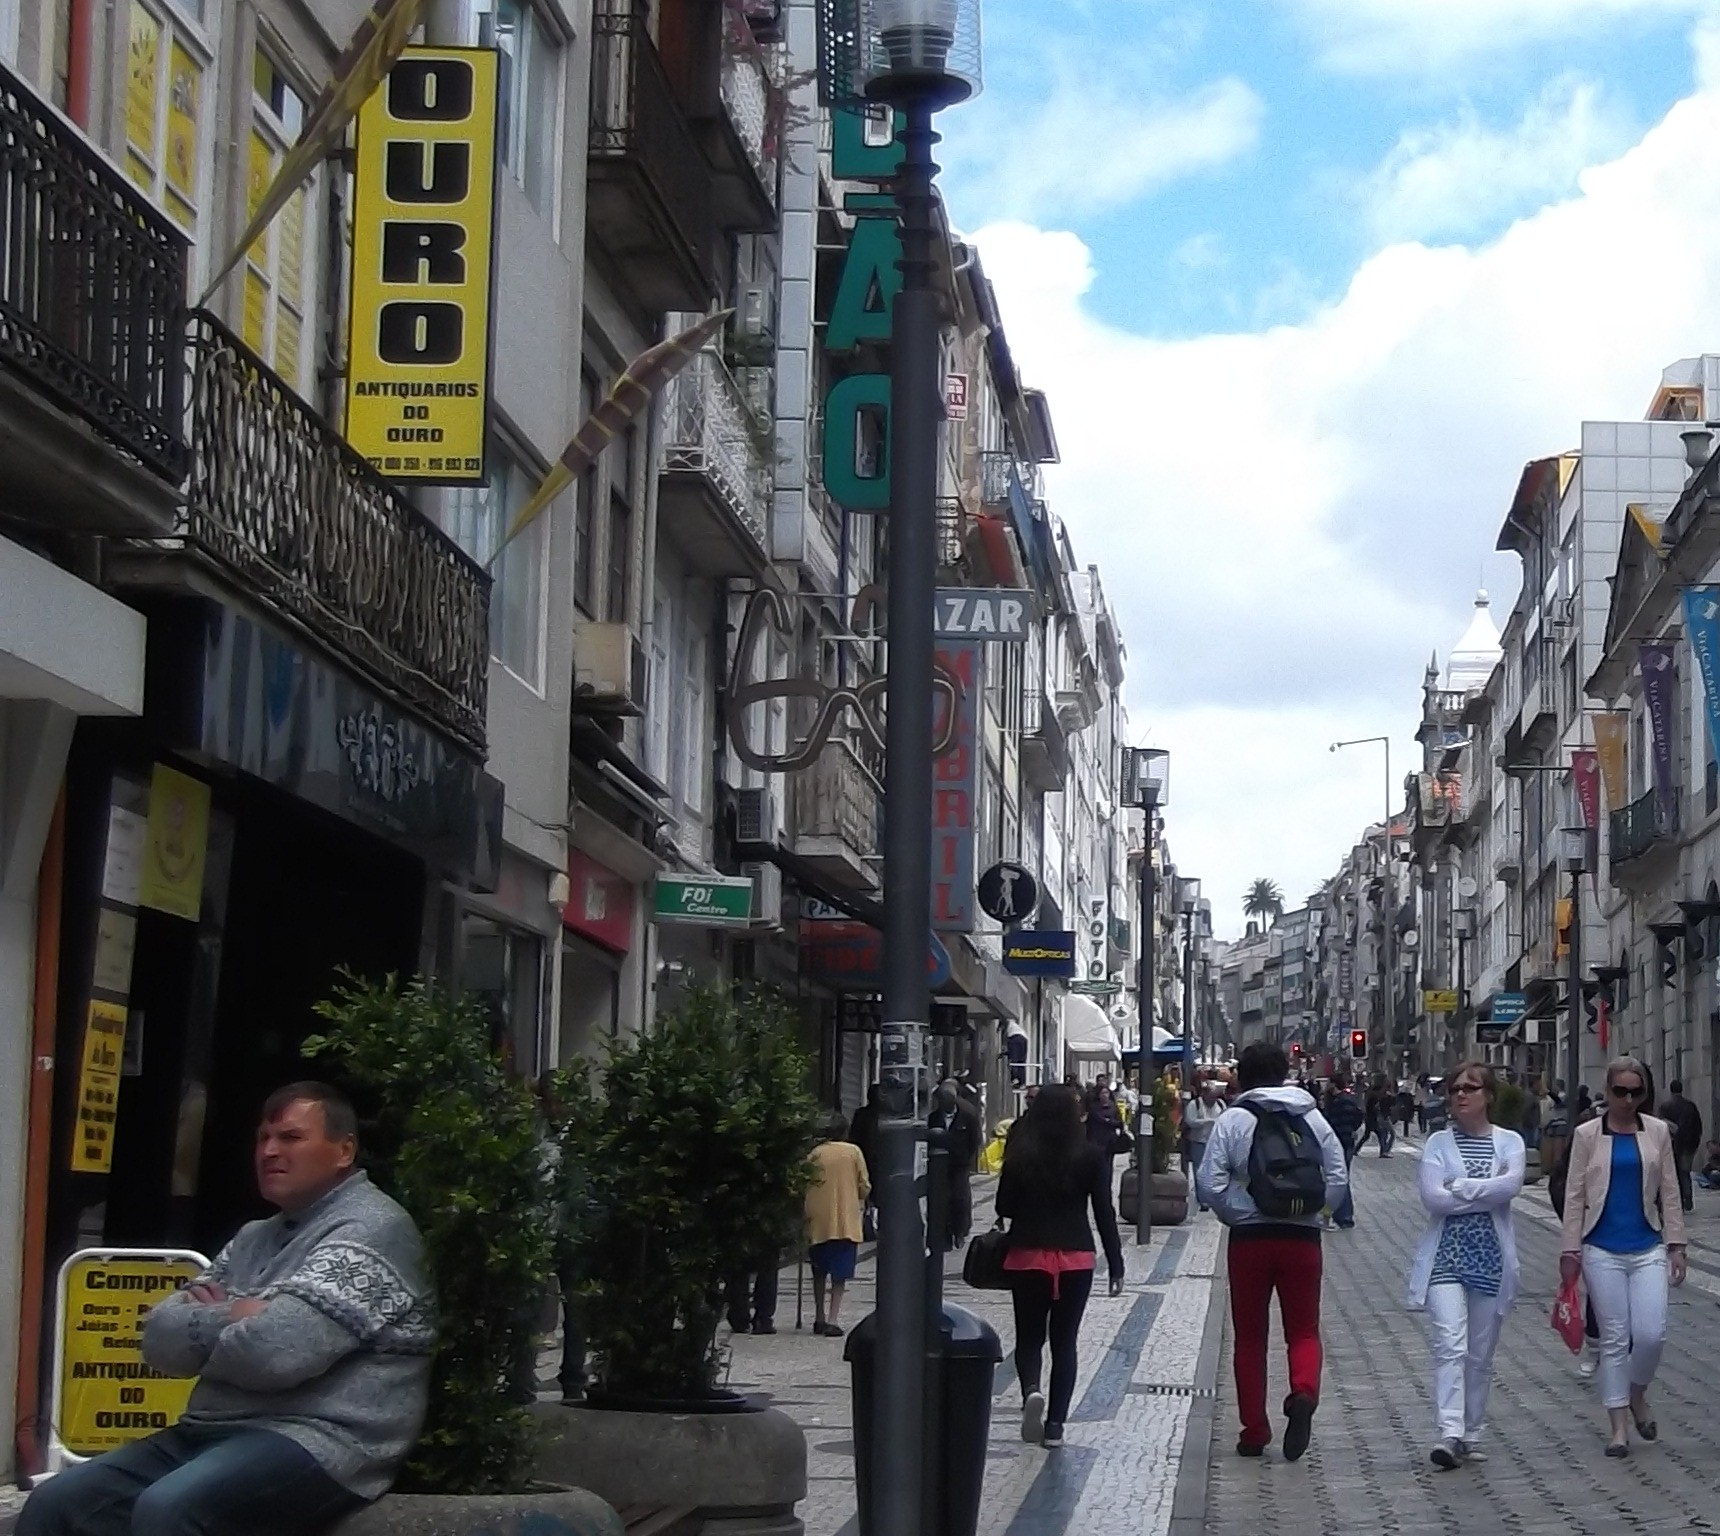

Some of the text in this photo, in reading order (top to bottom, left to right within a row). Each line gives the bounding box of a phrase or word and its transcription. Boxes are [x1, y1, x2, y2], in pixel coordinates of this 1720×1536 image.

[376, 56, 475, 367] OURO
[355, 381, 479, 400] ANTIQUARIOS
[403, 405, 430, 420] DO
[387, 427, 444, 443] OURO
[1089, 899, 1105, 977] FOTO
[86, 1270, 189, 1294] Compro
[120, 1387, 145, 1405] DO
[96, 1411, 168, 1429] OURO
